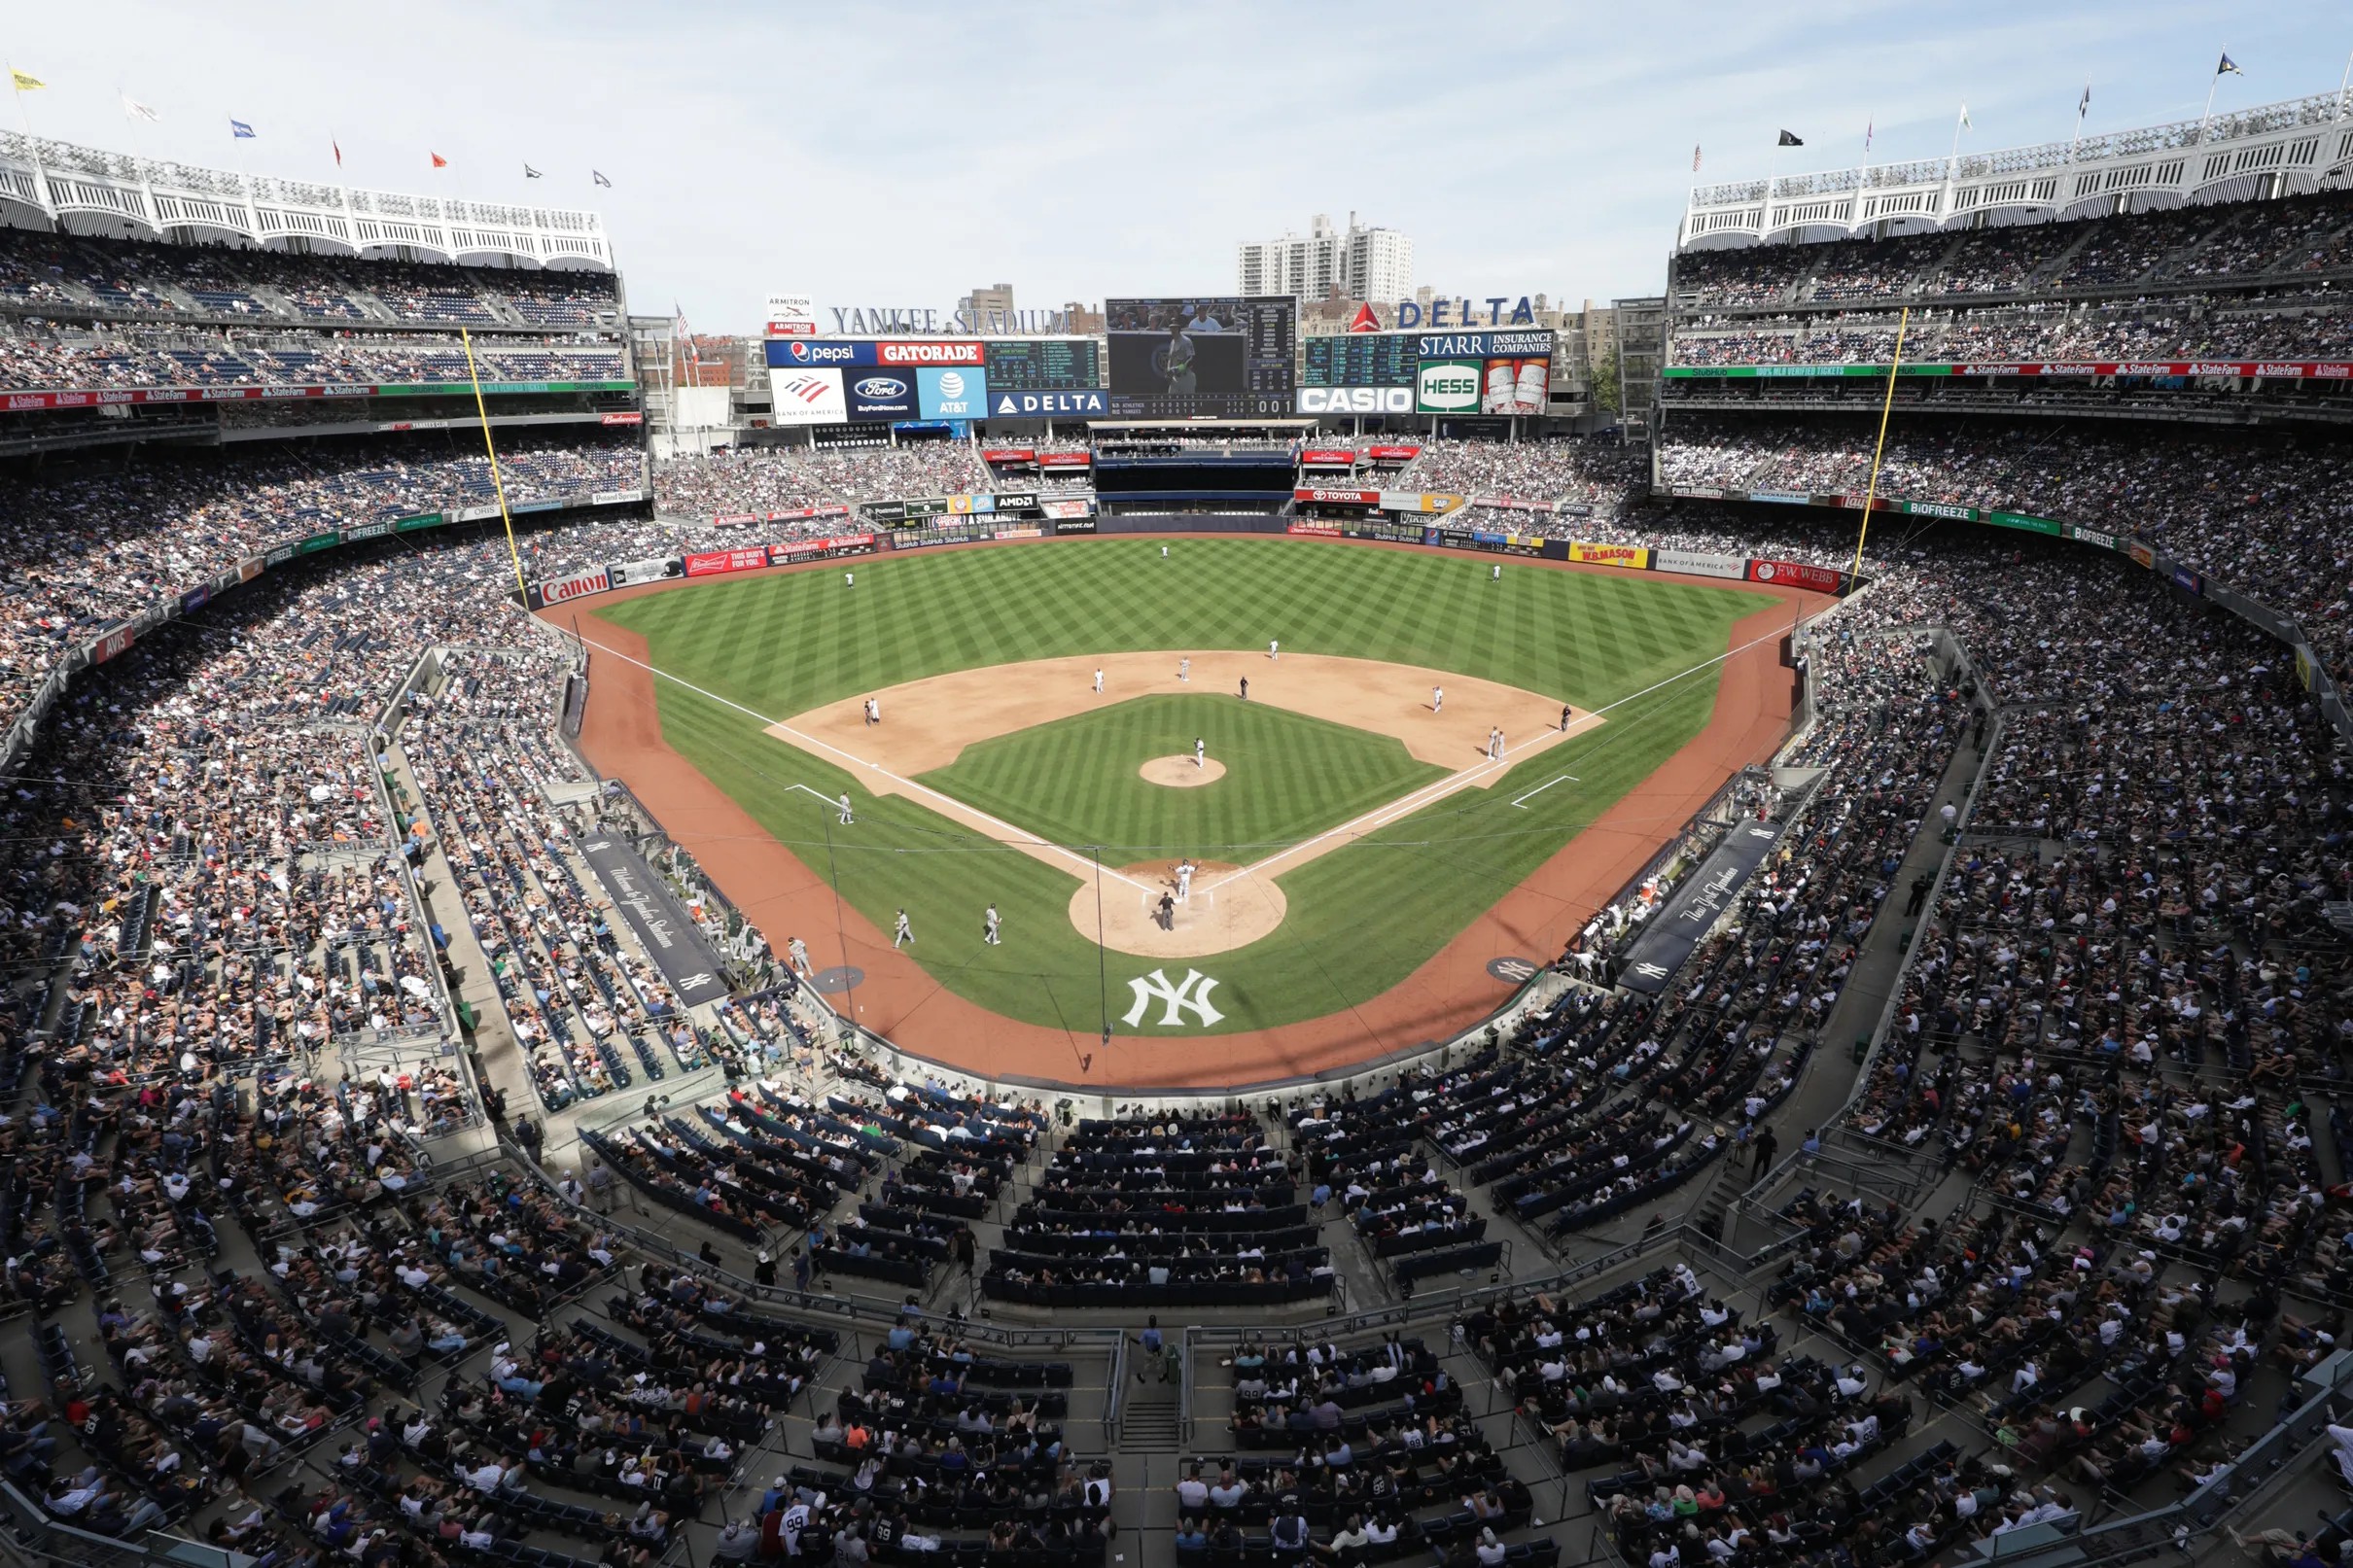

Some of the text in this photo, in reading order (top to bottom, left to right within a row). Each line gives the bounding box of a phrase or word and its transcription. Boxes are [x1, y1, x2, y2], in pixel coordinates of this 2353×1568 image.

[1398, 296, 1534, 328] DELTA
[829, 306, 1071, 335] YANKEE STADIUM
[1493, 333, 1552, 344] INSURANCE
[1419, 336, 1485, 355] STARR
[1492, 343, 1552, 353] COMPANIES
[812, 345, 854, 361] pepsi
[884, 345, 978, 361] GATORADE
[1692, 368, 1727, 376] StubHub
[1788, 367, 1815, 376] VERIFIED
[1816, 367, 1844, 375] TICKETS
[1876, 366, 1916, 375] StuHub
[409, 385, 444, 394] StubHub
[574, 383, 606, 391] StubHub
[864, 381, 897, 397] Ford
[1424, 379, 1474, 394] HESS
[1024, 394, 1102, 412] DELTA
[1300, 389, 1413, 412] CASIO
[939, 402, 968, 413] AT&T
[1259, 401, 1290, 413] 0 0 1
[596, 492, 639, 503] Poland Spring
[1327, 491, 1362, 500] TOYOTA
[1672, 487, 1723, 497] Parts Authority
[1000, 498, 1024, 506] AMD
[1433, 498, 1447, 507] SAP
[474, 506, 495, 515] ORIS
[968, 516, 974, 525] A
[945, 536, 969, 544] StubHub
[1374, 533, 1421, 544] StubHub StubHub
[1601, 549, 1636, 560] MASON
[1691, 561, 1724, 570] AMERICA
[1776, 565, 1833, 584] F.W. WEBB
[543, 573, 607, 602] Canon
[106, 631, 126, 657] AVIS
[611, 867, 634, 893] Welcome
[1679, 867, 1738, 922] New York Yankees
[620, 895, 656, 919] Yankee
[646, 918, 674, 948] Stadium
[565, 1405, 576, 1416] 27
[653, 1478, 662, 1490] 11
[1374, 1481, 1385, 1495] 99
[786, 1516, 803, 1533] 99
[877, 1526, 891, 1541] 99
